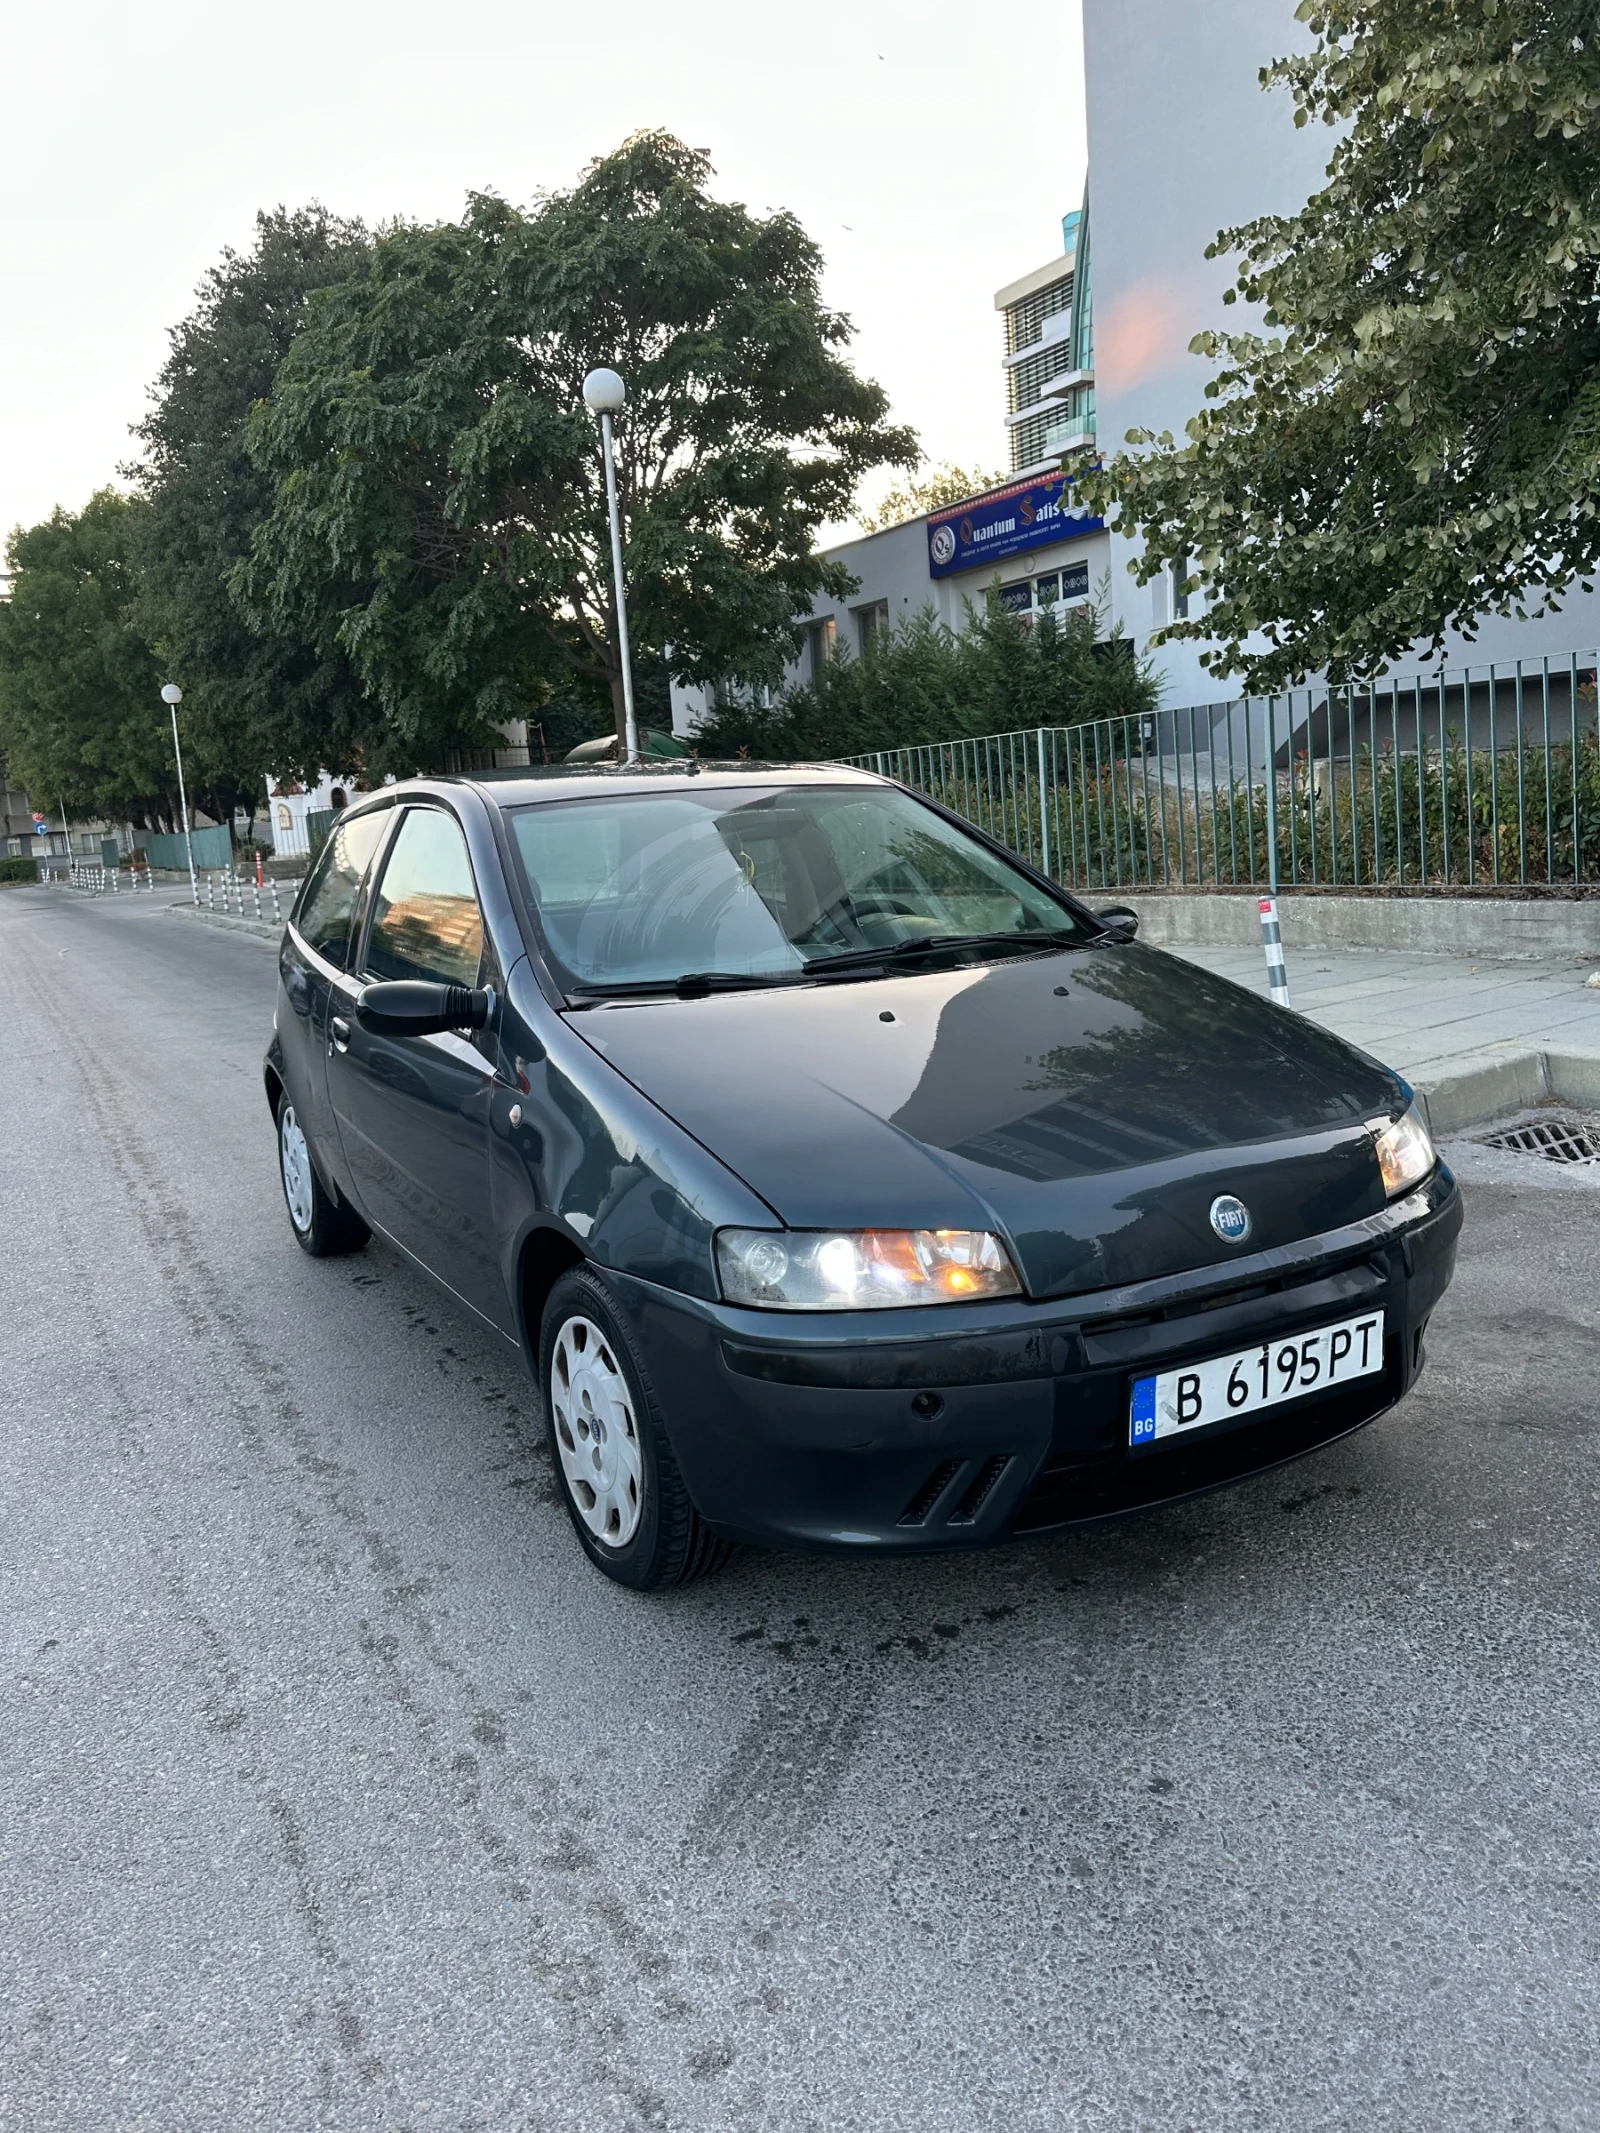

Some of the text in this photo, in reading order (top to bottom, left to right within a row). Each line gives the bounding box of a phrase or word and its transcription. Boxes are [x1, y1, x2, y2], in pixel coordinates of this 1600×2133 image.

[960, 517, 1016, 546] Quantum
[1019, 495, 1061, 526] Satis
[1218, 1209, 1244, 1229] FIAT
[1177, 1373, 1203, 1425] B
[1134, 1417, 1154, 1436] BG
